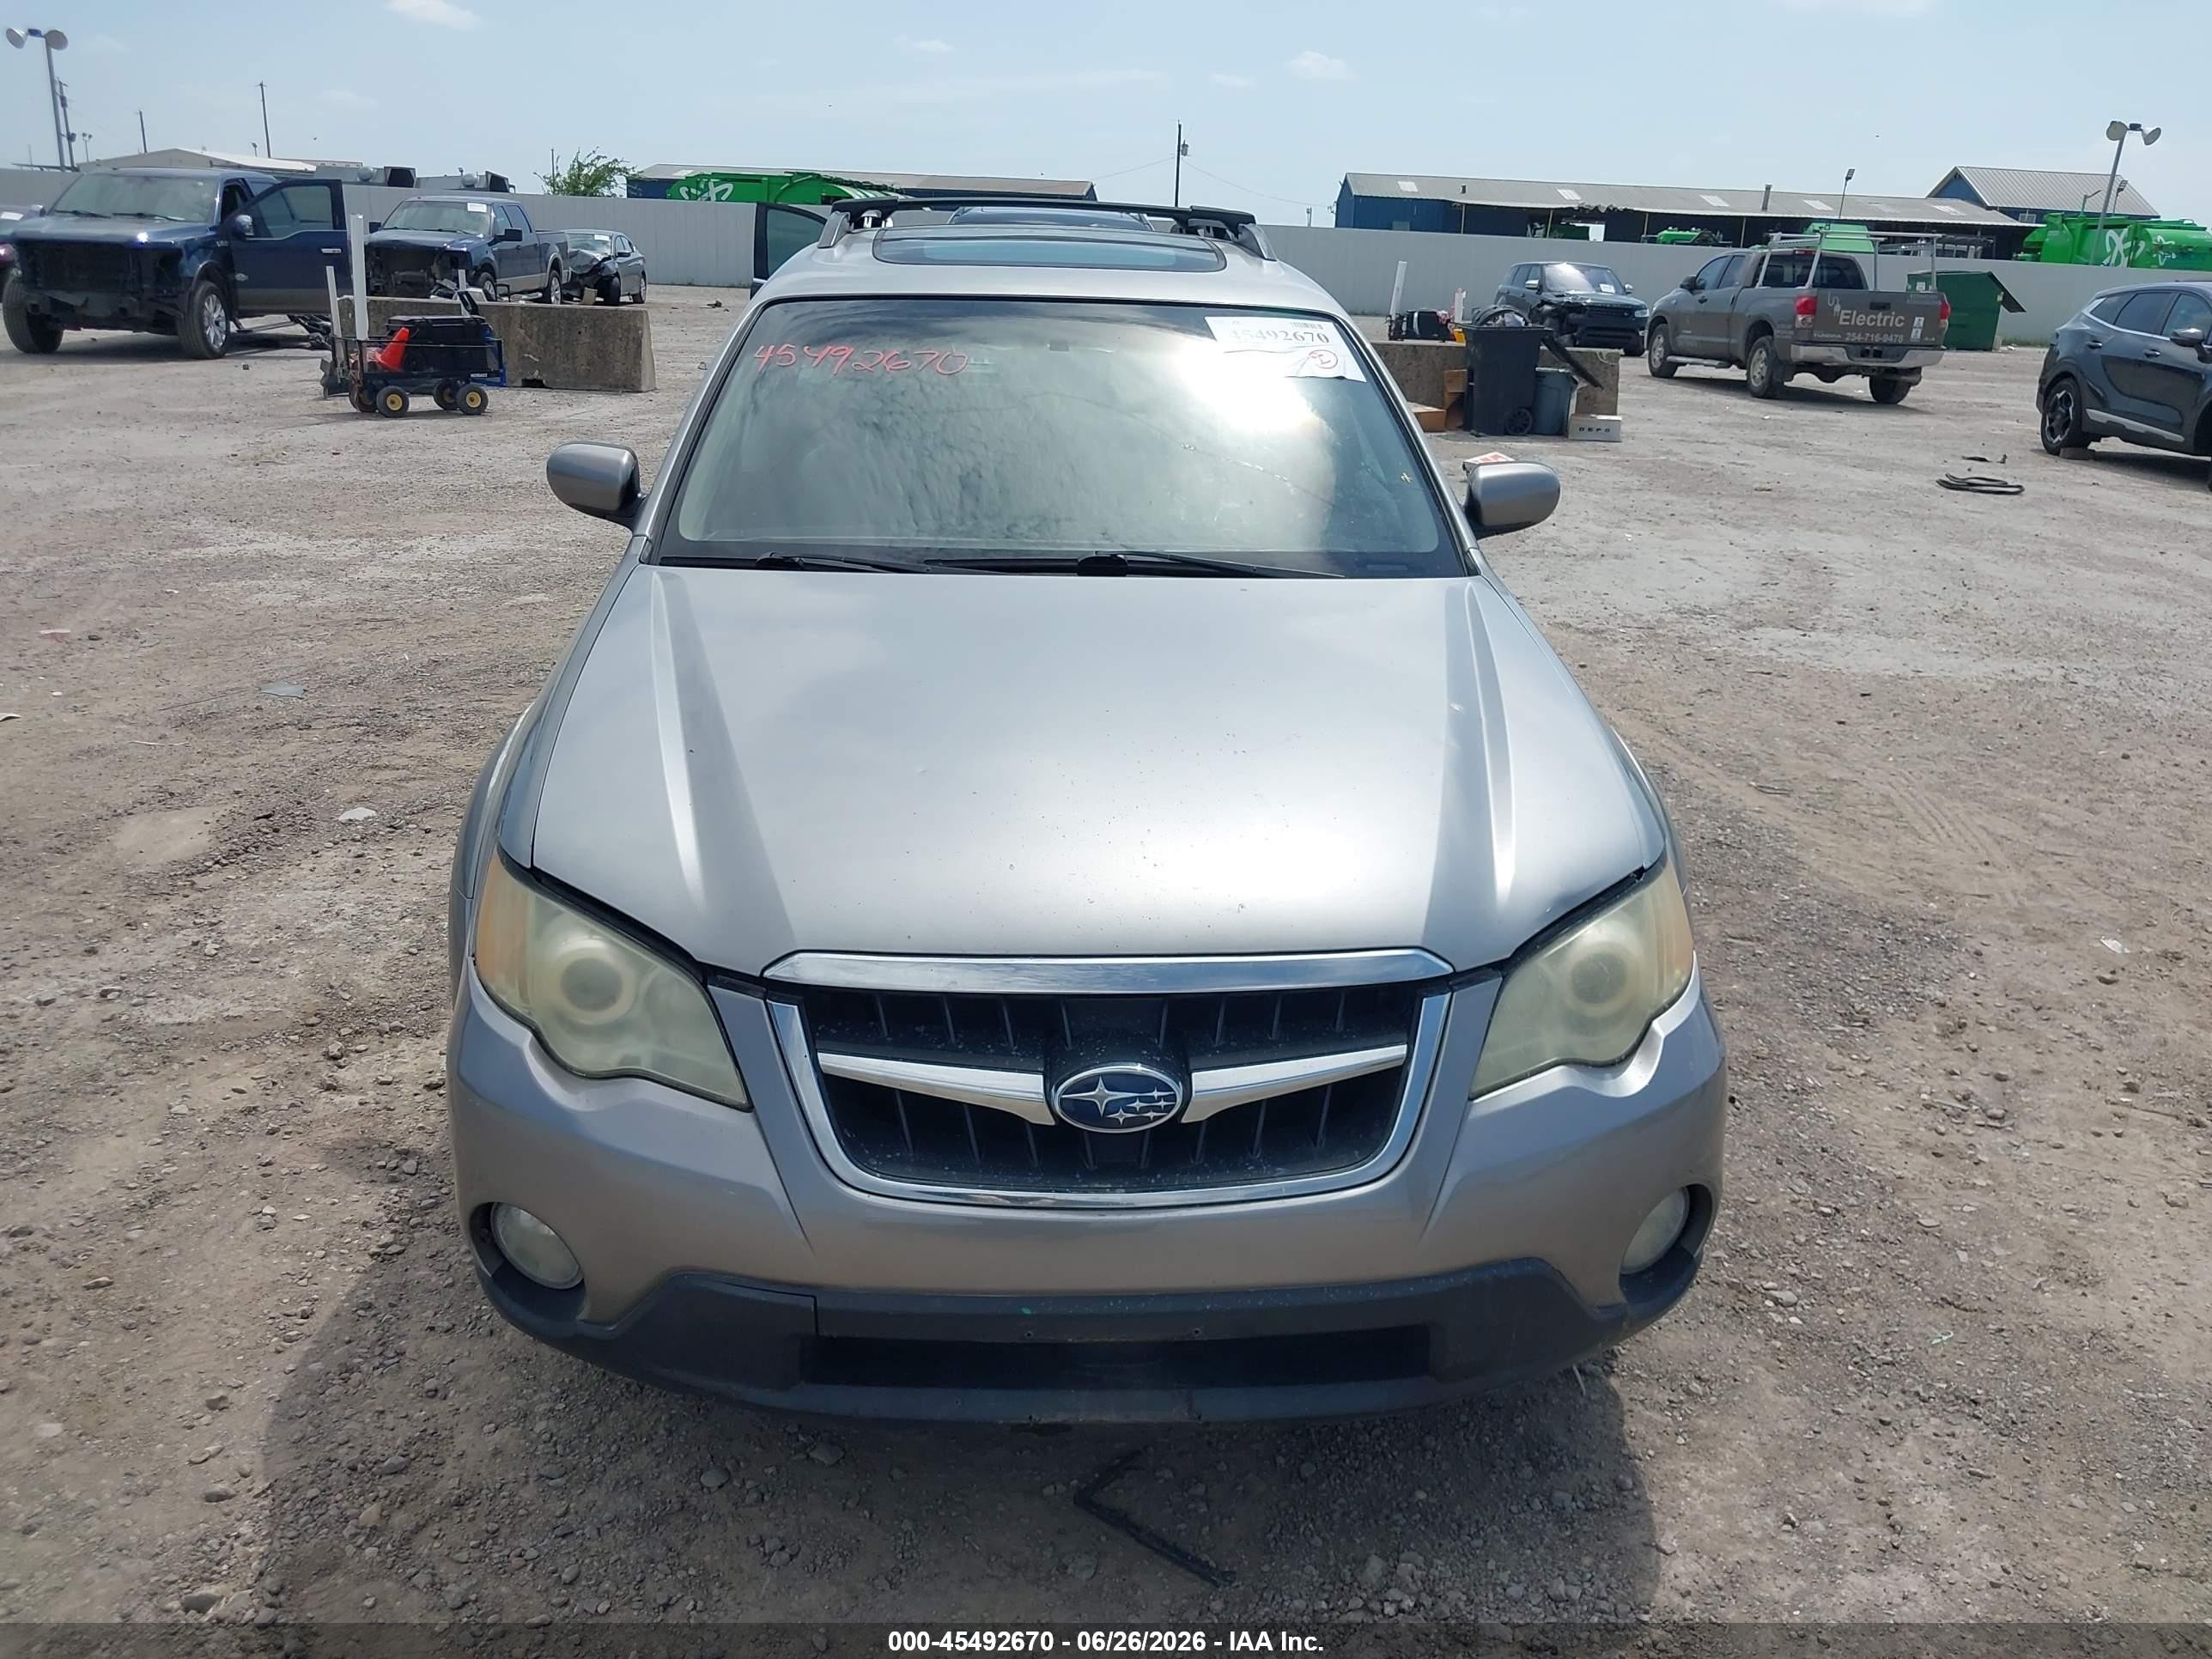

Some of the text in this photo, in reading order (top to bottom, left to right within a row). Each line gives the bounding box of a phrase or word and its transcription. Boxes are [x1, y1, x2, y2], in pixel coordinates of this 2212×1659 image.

[1838, 309, 1905, 327] Electric
[1229, 328, 1330, 345] 45492670
[753, 343, 969, 375] 45492670
